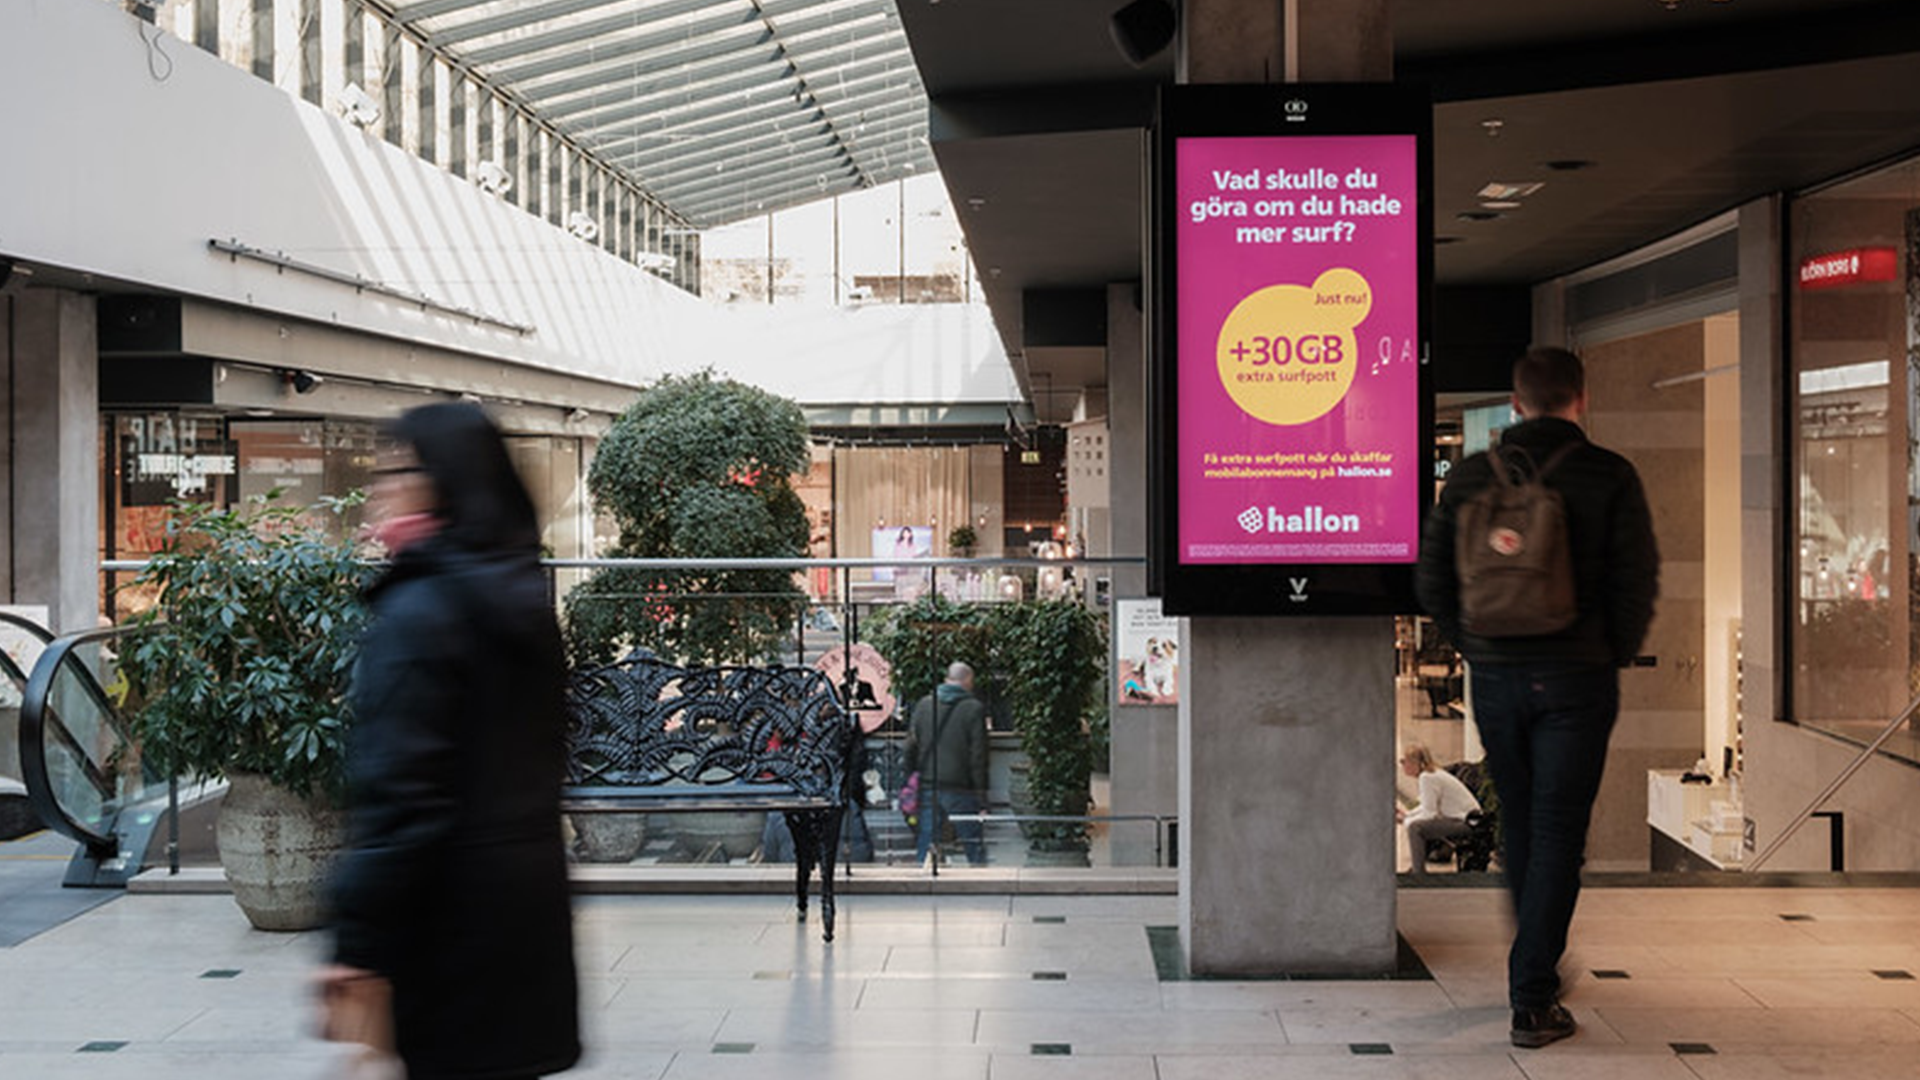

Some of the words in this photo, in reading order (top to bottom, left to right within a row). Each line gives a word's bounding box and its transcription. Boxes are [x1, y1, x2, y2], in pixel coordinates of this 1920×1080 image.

[1212, 169, 1259, 190] Vad
[1266, 168, 1338, 190] skulle
[1345, 168, 1377, 189] du
[1190, 196, 1247, 222] göra
[1254, 200, 1294, 216] om
[1301, 195, 1333, 216] du
[1340, 194, 1401, 215] hade
[1236, 226, 1286, 243] mer
[1292, 221, 1356, 243] surf?
[1314, 292, 1341, 305] Just
[1344, 292, 1367, 305] nu!
[1236, 370, 1274, 383] extra
[1279, 369, 1337, 385] surfpott
[1204, 453, 1218, 465] Få
[1221, 455, 1252, 465] extra
[1255, 453, 1306, 467] surfpott
[1308, 452, 1328, 464] når
[1331, 452, 1347, 463] du
[1350, 451, 1392, 463] skaffar
[1204, 466, 1316, 480] mobilabonnemang
[1320, 466, 1335, 479] på
[1338, 466, 1392, 477] hallon.se
[1267, 506, 1359, 532] hallon
